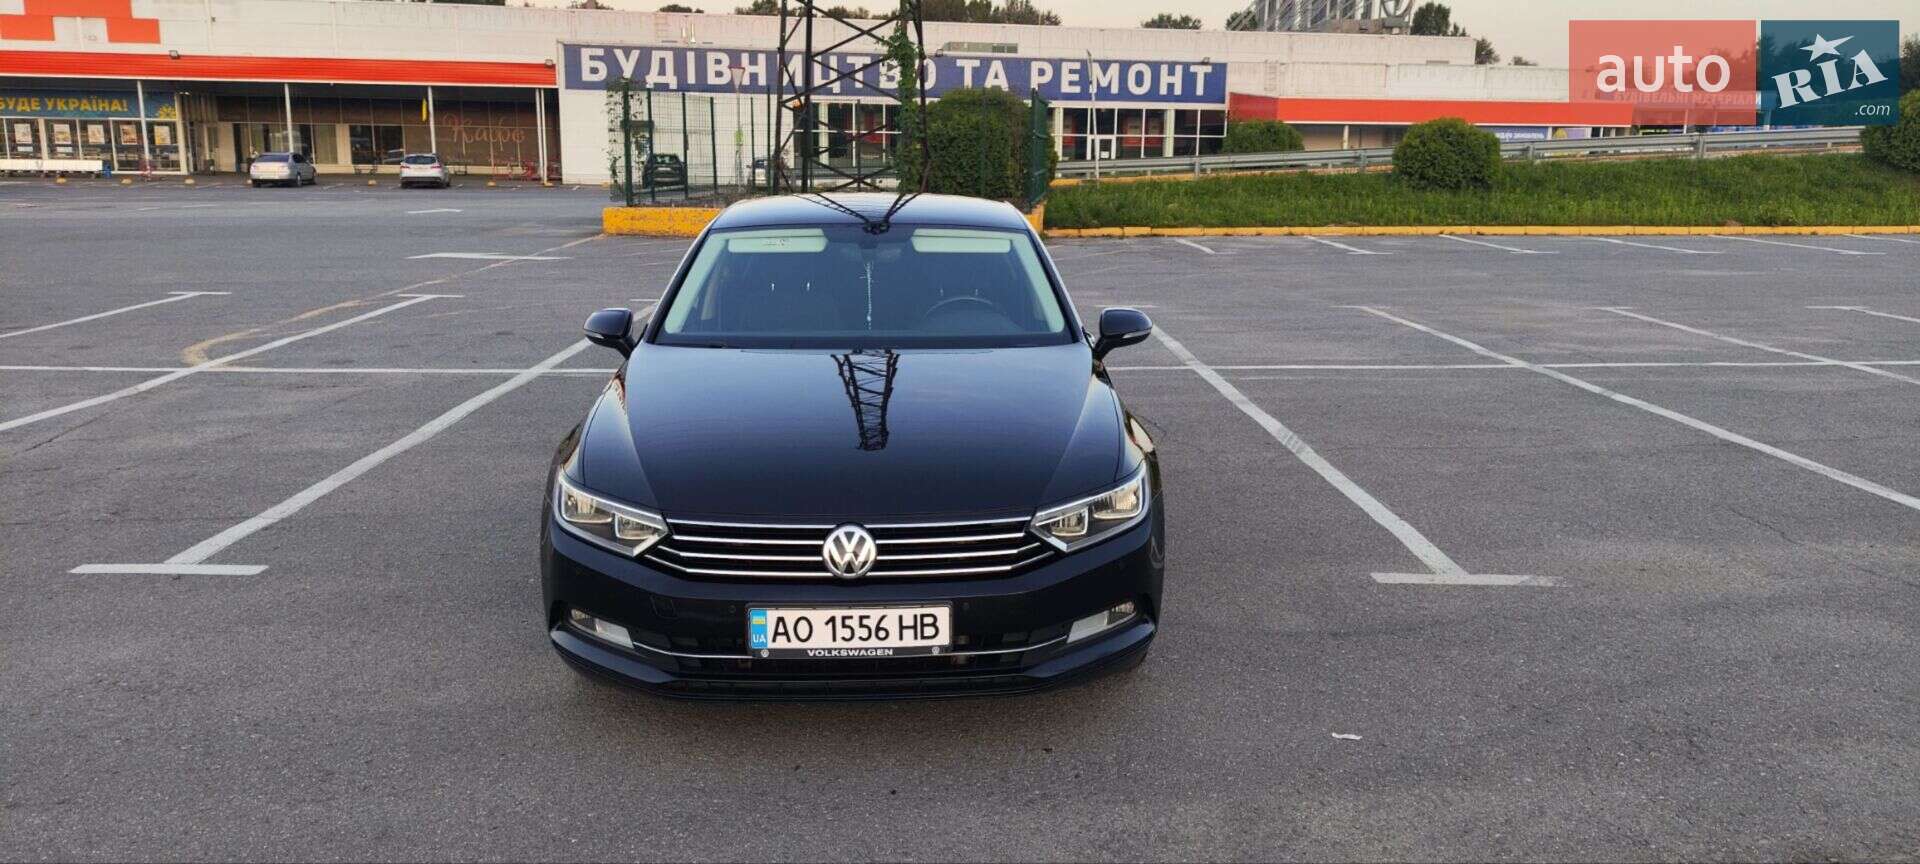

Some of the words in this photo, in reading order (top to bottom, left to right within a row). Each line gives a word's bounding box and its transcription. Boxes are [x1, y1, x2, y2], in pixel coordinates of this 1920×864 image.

[580, 47, 937, 93] БУДІВНИЦТВО
[956, 59, 1010, 91] ТА
[1030, 61, 1212, 96] РЕМОНТ
[0, 97, 41, 112] БУДЕ
[45, 96, 129, 112] УКРАЇНА!
[771, 616, 813, 643] AO
[824, 614, 890, 643] 1556
[898, 613, 940, 641] HB
[753, 633, 767, 644] UA
[807, 648, 893, 657] VOLKSWAGEN
